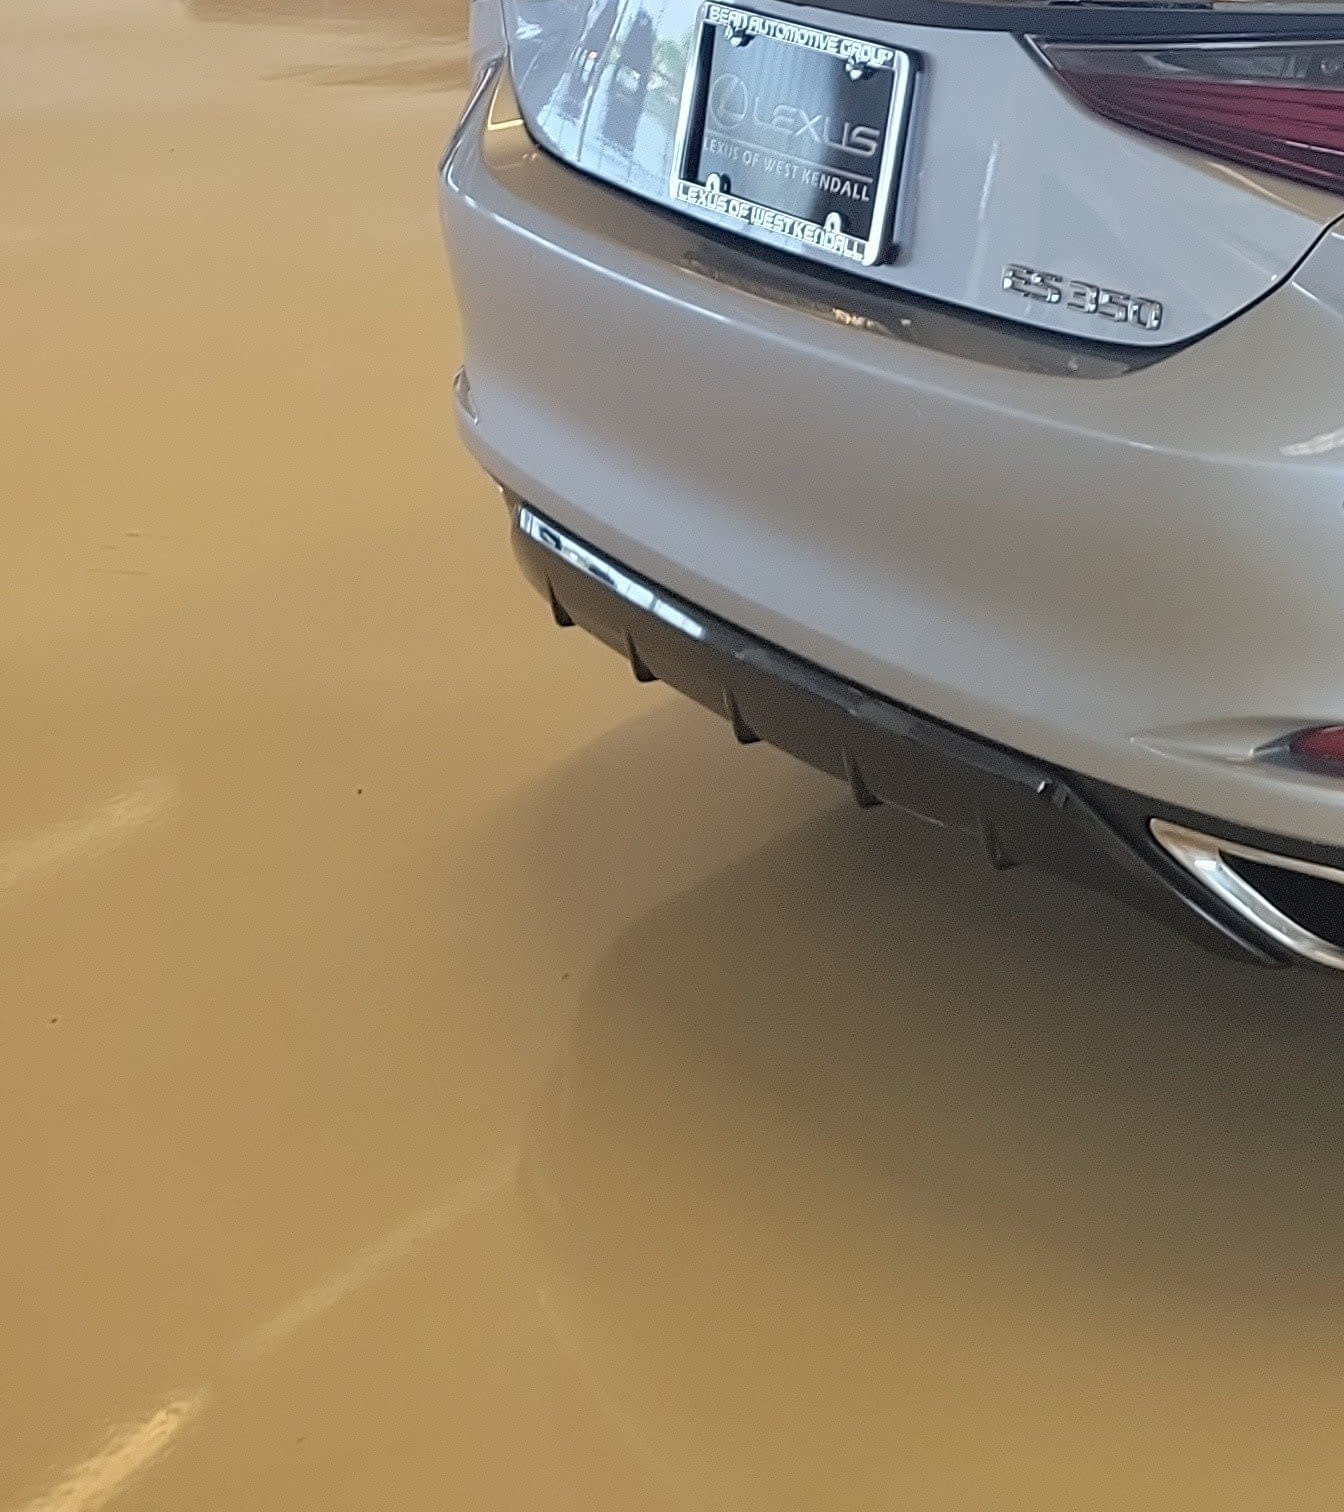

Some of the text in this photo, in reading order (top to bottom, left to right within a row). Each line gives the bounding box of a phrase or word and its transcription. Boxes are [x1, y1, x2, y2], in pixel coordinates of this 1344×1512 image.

[709, 5, 894, 65] BEAN AUTOMOTIVE GROUP
[754, 96, 880, 158] LEXUS
[703, 137, 870, 202] LEXUS OF WEST KENDALL
[678, 182, 865, 261] LEXUS OF WEST KENDALL
[1002, 263, 1163, 331] ES 350
